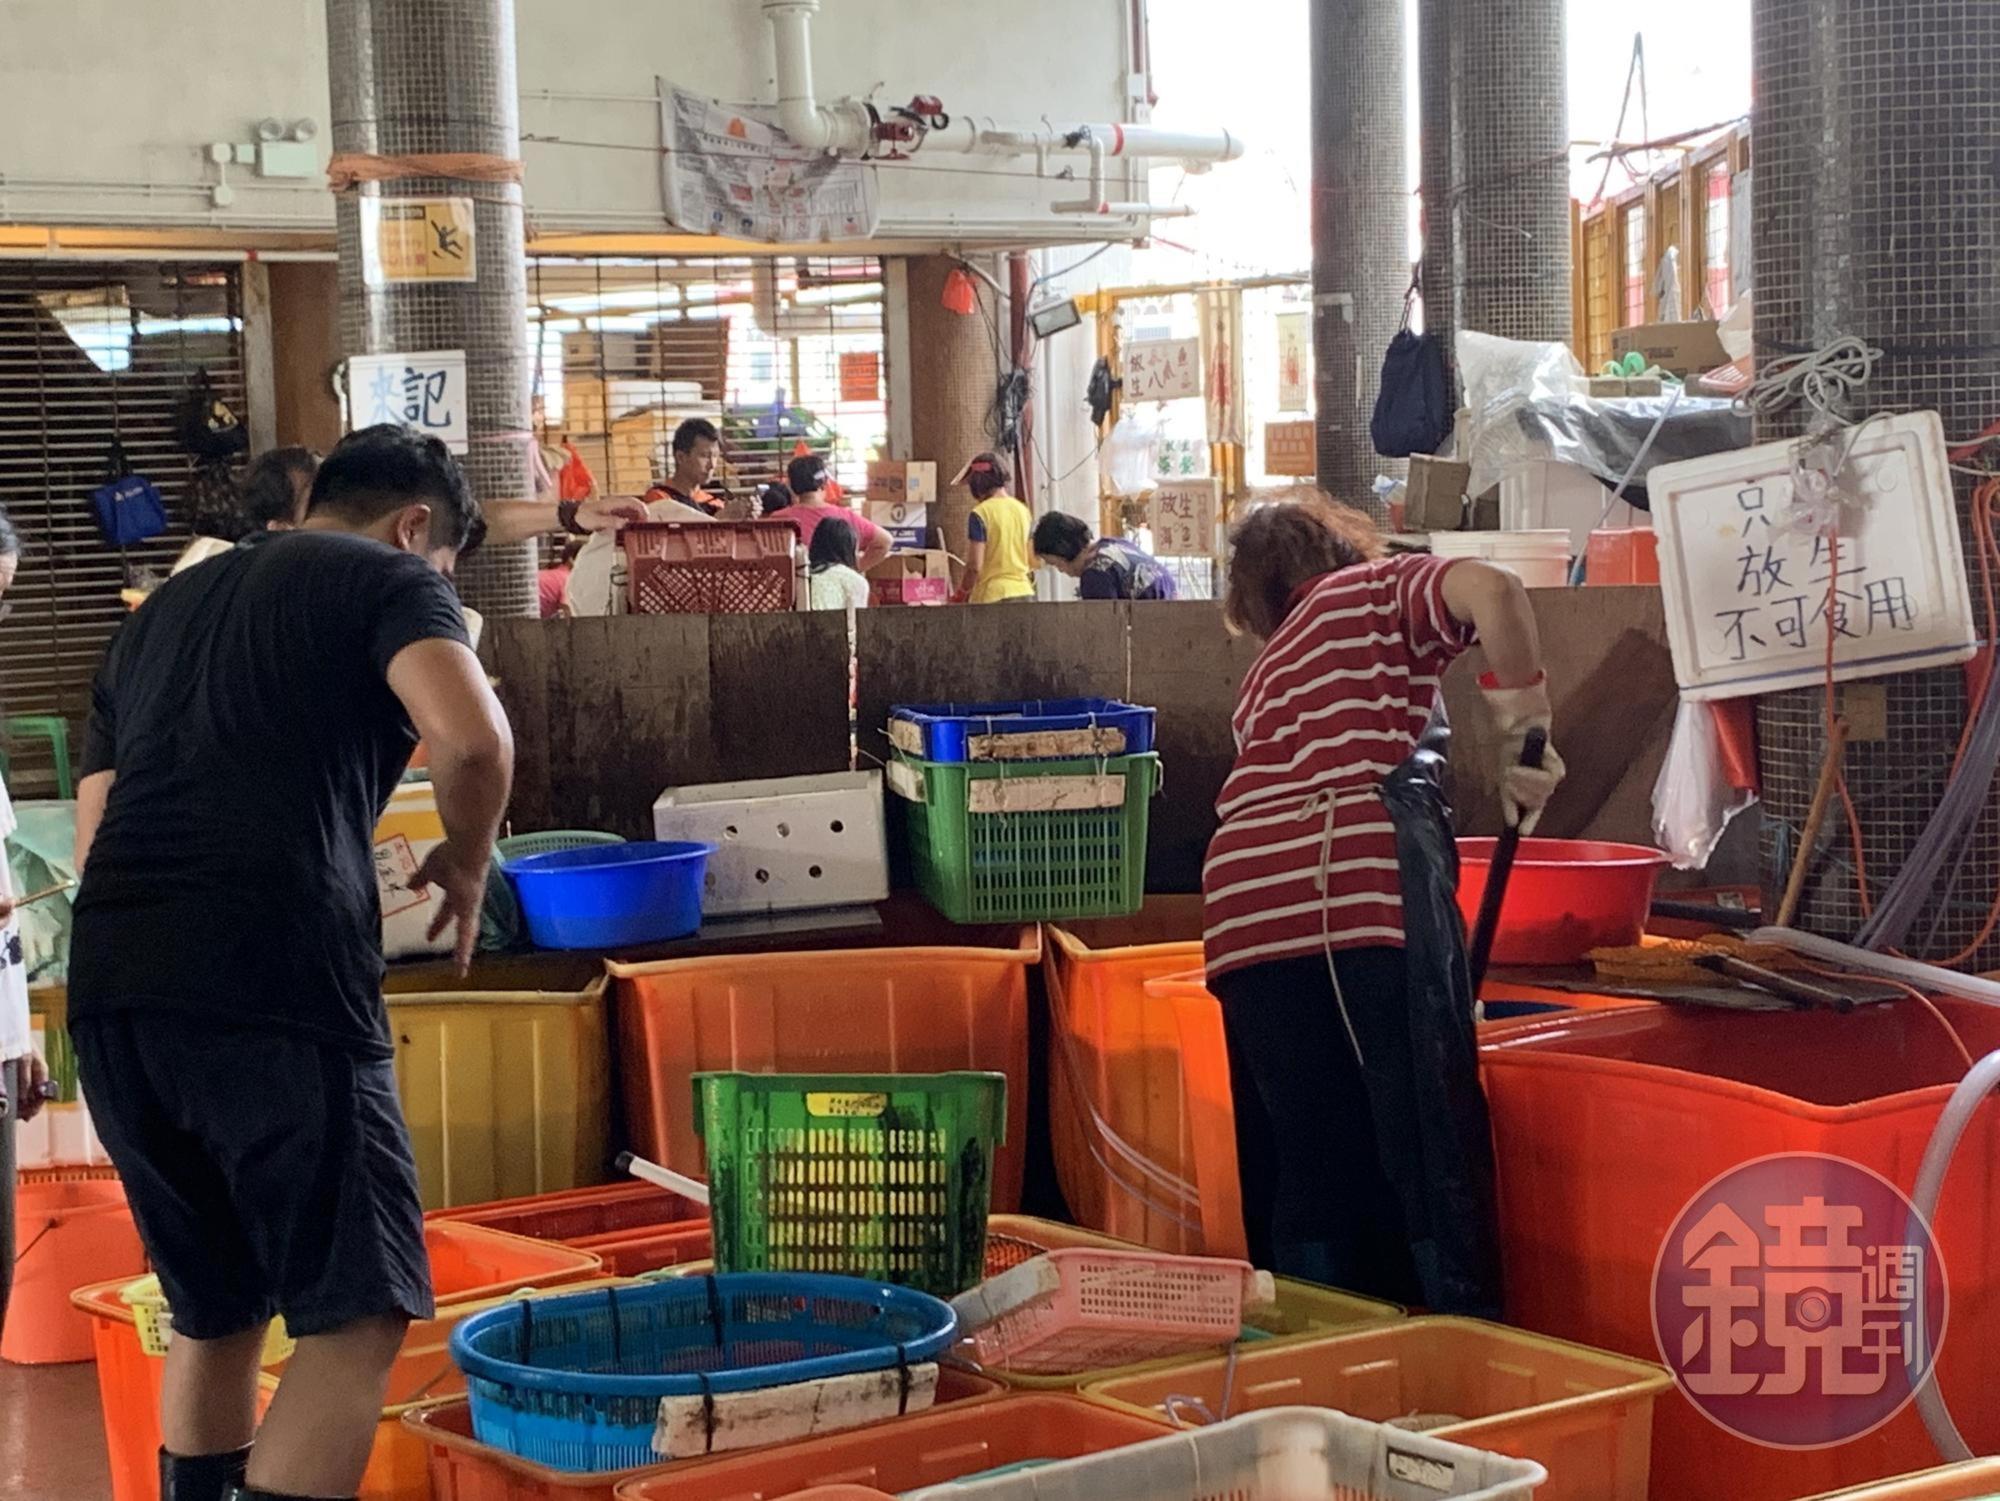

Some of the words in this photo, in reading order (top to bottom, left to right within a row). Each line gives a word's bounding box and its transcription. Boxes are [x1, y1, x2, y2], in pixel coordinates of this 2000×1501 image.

[1160, 491, 1195, 519] 放生
[1737, 486, 1772, 538] 只
[1737, 534, 1867, 596] 放生
[1714, 576, 1914, 661] 不可食用
